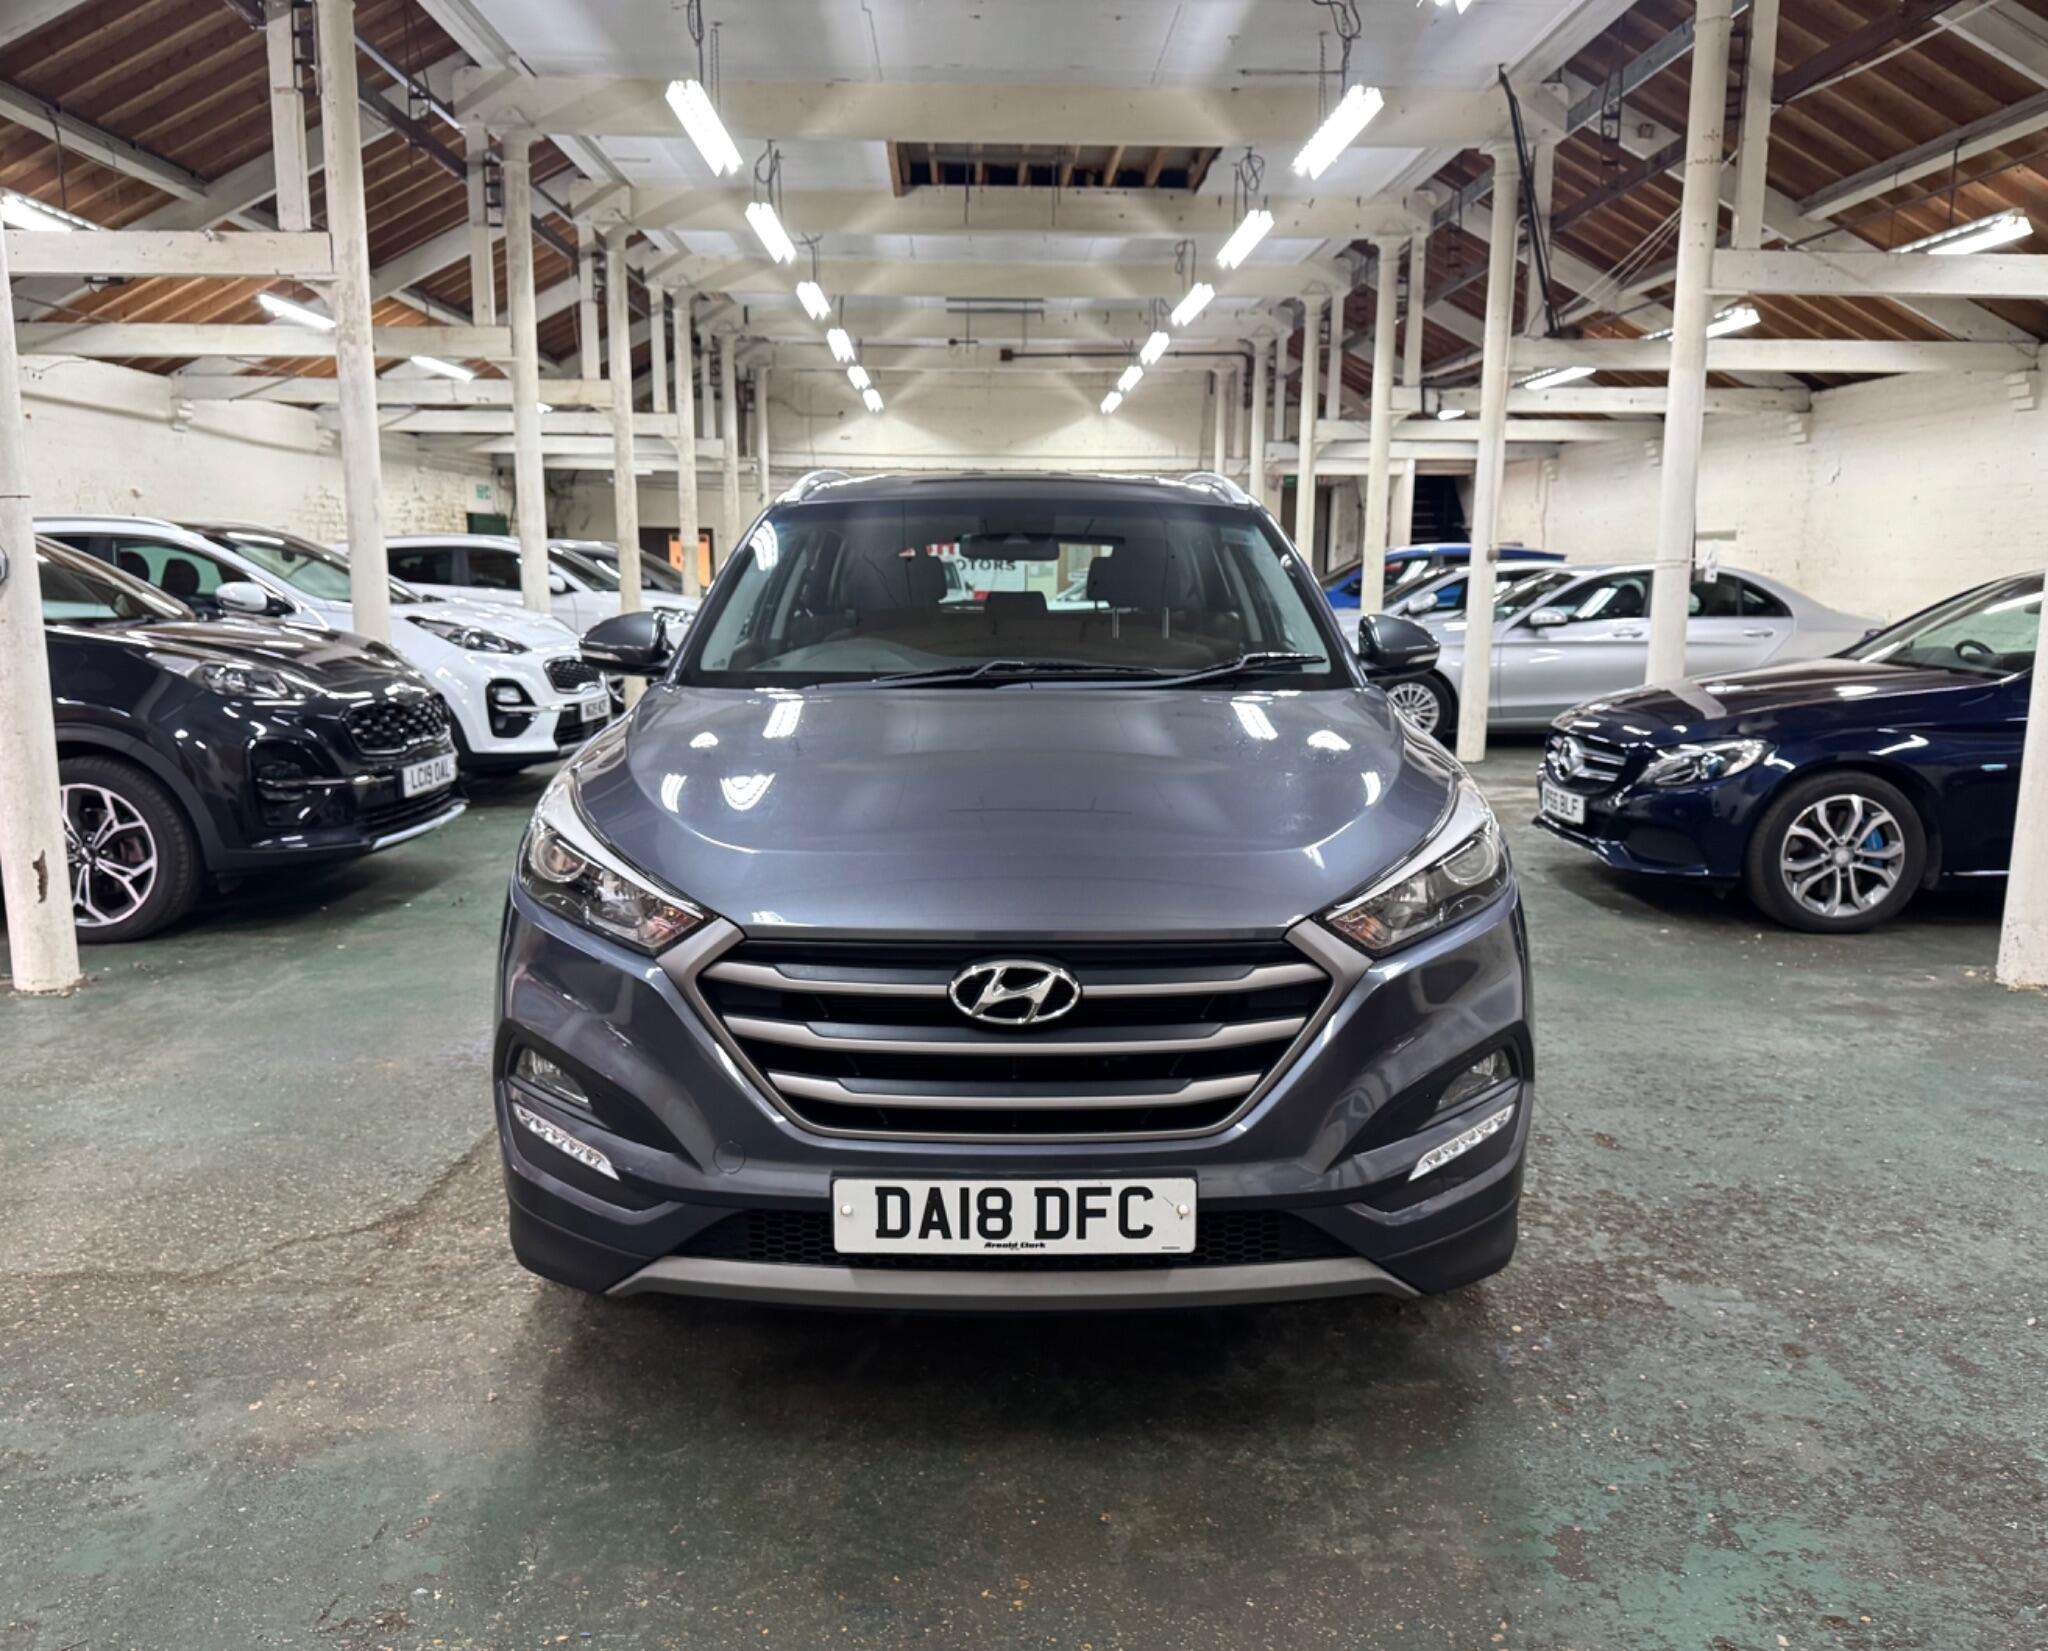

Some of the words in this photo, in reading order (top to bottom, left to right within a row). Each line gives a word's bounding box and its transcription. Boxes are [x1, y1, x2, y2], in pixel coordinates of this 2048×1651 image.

[956, 558, 1016, 571] OTORS
[875, 1186, 1013, 1241] DA18
[1034, 1186, 1154, 1241] DFC
[984, 1241, 1018, 1250] Arnold
[1020, 1241, 1046, 1249] Clark
